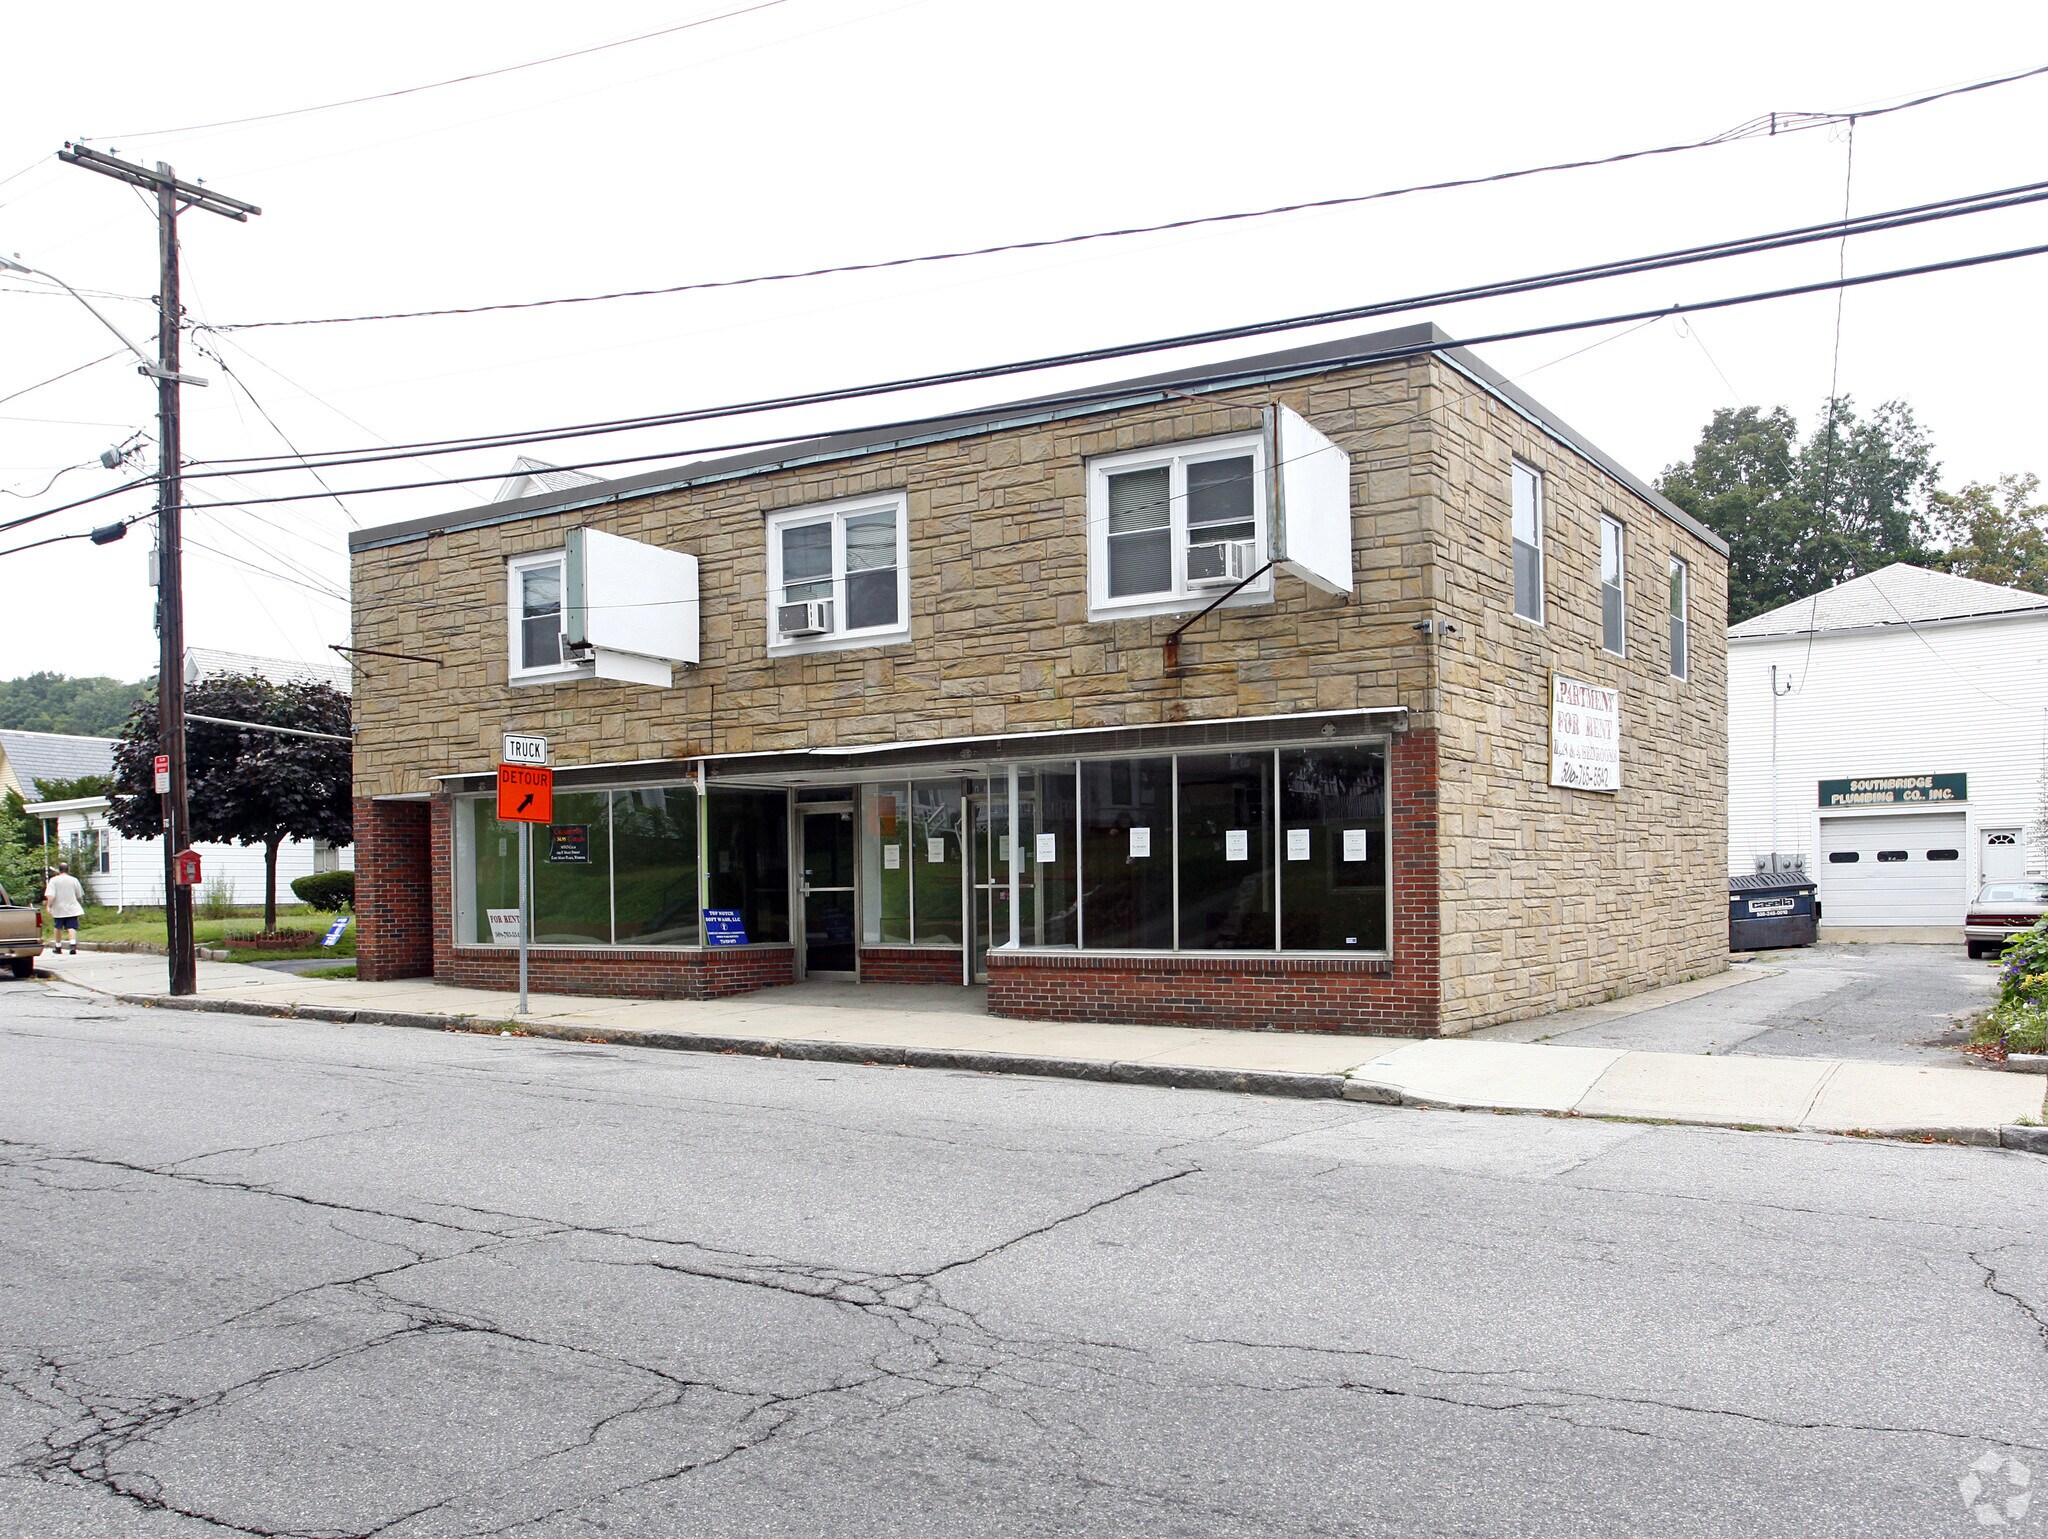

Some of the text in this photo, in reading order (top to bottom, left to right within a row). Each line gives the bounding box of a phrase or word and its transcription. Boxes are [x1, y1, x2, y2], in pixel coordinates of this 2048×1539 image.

[1557, 711, 1613, 739] FOR RENT
[510, 741, 541, 758] TRUCK
[502, 770, 548, 786] DETOUR
[1850, 776, 1933, 791] SOUTHBRIDGE
[1831, 791, 1894, 804] PLUMBING
[1929, 788, 1955, 800] INC.
[1752, 898, 1793, 909] casella
[490, 915, 520, 923] FOR RENT
